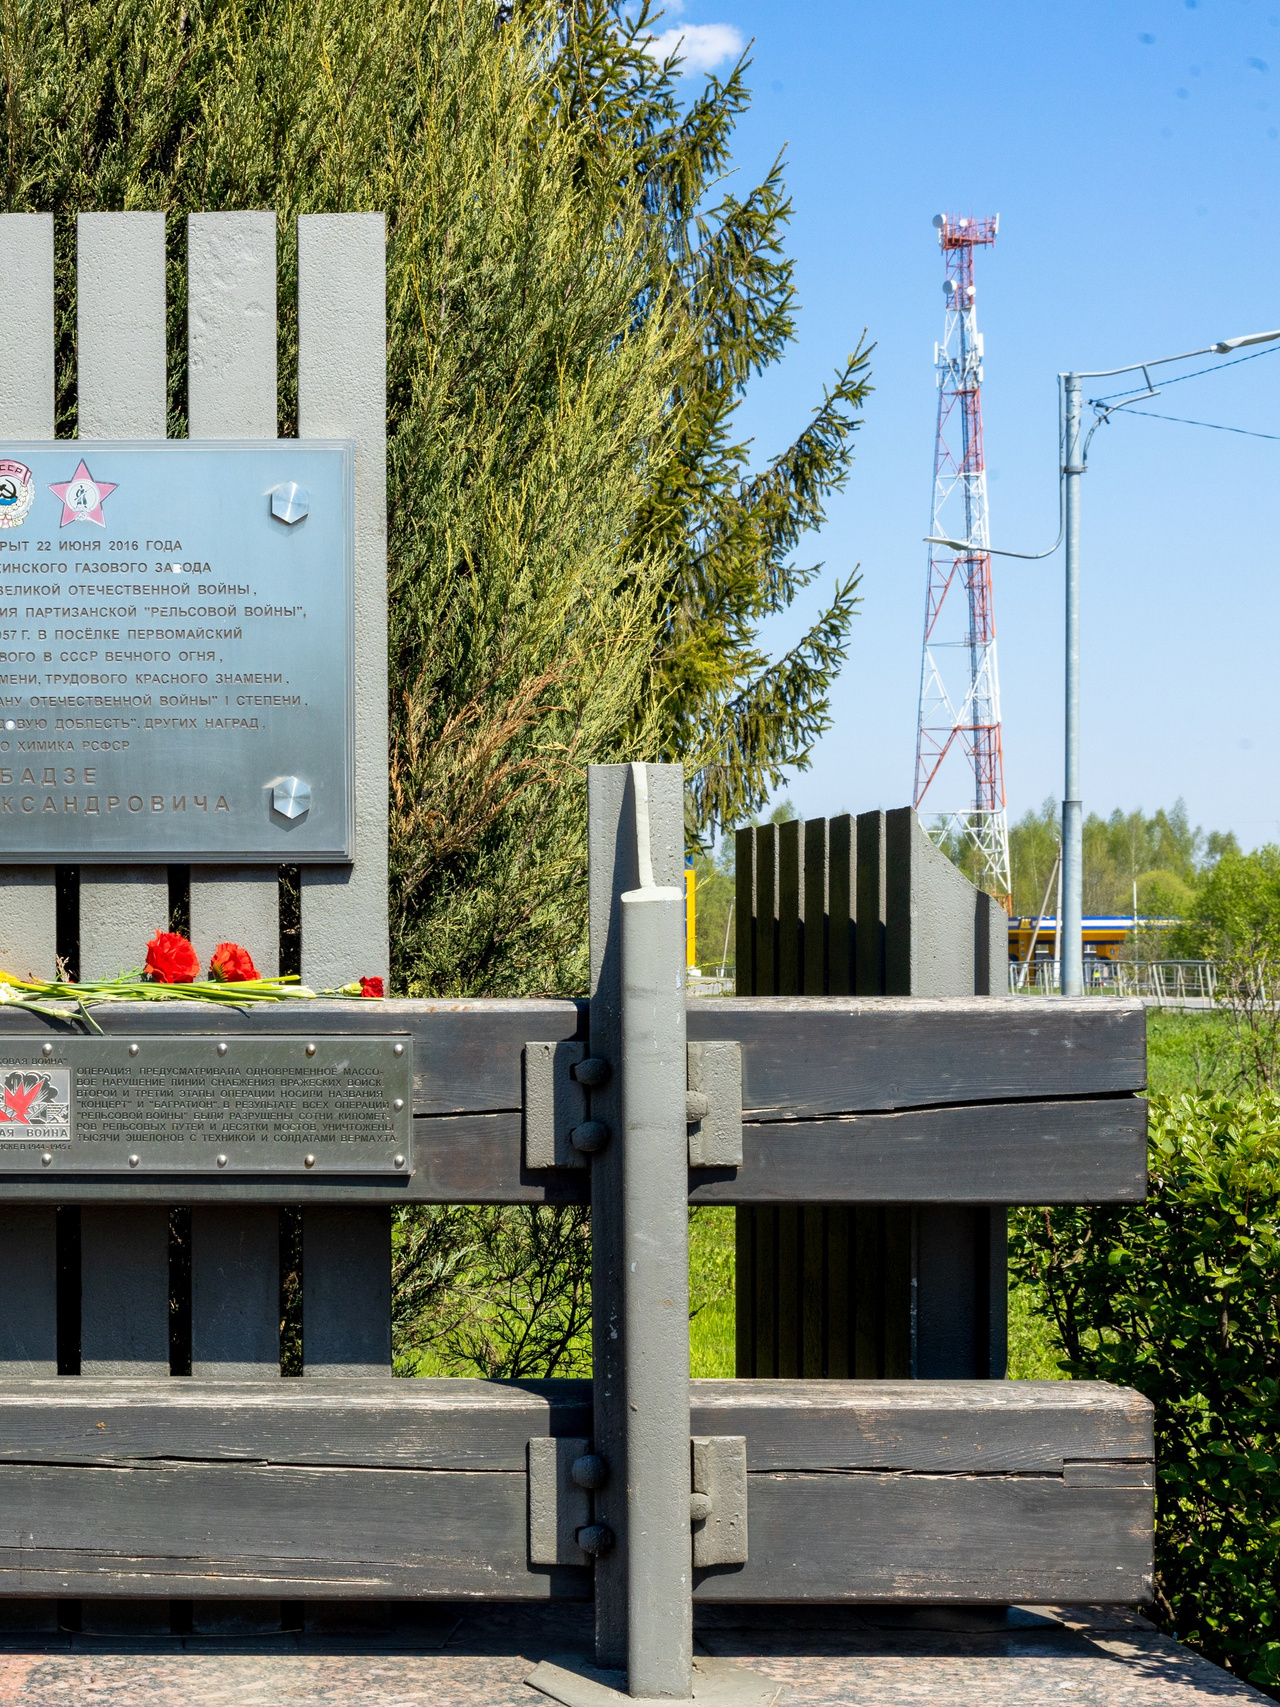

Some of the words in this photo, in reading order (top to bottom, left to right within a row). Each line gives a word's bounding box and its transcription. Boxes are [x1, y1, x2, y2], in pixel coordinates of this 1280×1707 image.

[36, 541, 51, 552] 22
[59, 541, 101, 552] ИЮНЯ
[108, 540, 139, 551] 2016
[146, 540, 183, 553] ГОДА
[75, 563, 148, 574] ГАЗОВОГО
[68, 583, 190, 596] ОТЕЧЕСТВЕННОЙ
[25, 605, 137, 618] ПАРТИЗАНСКОЙ
[144, 605, 237, 618] "РЕЛЬСОВОЙ
[38, 630, 47, 641] В
[55, 627, 120, 640] ПОСЁЛКЕ
[127, 627, 243, 640] ПЕРВОМАЙСКИЙ
[43, 652, 53, 663] В
[60, 652, 98, 663] СССР
[105, 651, 171, 662] ВЕЧНОГО
[45, 674, 128, 687] ТРУДОВОГО
[135, 674, 208, 685] КРАСНОГО
[29, 694, 152, 707] ОТЕЧЕСТВЕННОЙ
[159, 694, 218, 707] ВОЙНЫ"
[143, 718, 198, 731] ДРУГИХ
[17, 741, 75, 752] ХИМИКА
[82, 740, 130, 752] РСФСР
[76, 1067, 132, 1077] ОПЕРАЦИЯ
[139, 1067, 241, 1077] ПРЕДУСМАТРИВАЛА
[246, 1067, 338, 1077] ОДНОВРЕМЕННОЕ
[76, 1078, 97, 1087] ВОЕ
[102, 1078, 166, 1087] НАРУШЕНИЕ
[171, 1077, 206, 1087] ЛИНИЙ
[211, 1078, 275, 1087] СНАБЖЕНИЯ
[280, 1078, 342, 1087] ВРАЖЕСКИХ
[76, 1088, 117, 1098] ВТОРОЙ
[135, 1088, 174, 1098] ТРЕТИЙ
[179, 1090, 215, 1098] ЭТАПЫ
[220, 1090, 275, 1099] ОПЕРАЦИИ
[280, 1090, 323, 1098] НОСИЛИ
[328, 1090, 383, 1098] НАЗВАНИЯ
[235, 1101, 297, 1109] РЕЗУЛЬТАТЕ
[302, 1101, 329, 1109] ВСЕХ
[334, 1099, 390, 1111] ОПЕРАЦИЙ
[193, 1112, 224, 1120] БЫЛИ
[229, 1112, 293, 1120] РАЗРУШЕНЫ
[298, 1112, 333, 1120] СОТНИ
[26, 1127, 68, 1138] ВОЙНА
[76, 1123, 97, 1131] РОВ
[102, 1123, 166, 1131] РЕЛЬСОВЫХ
[172, 1122, 204, 1132] ПУТЕЙ
[222, 1123, 268, 1133] ДЕСЯТКИ
[322, 1123, 394, 1132] УНИЧТОЖЕНЫ
[78, 1134, 120, 1142] ТЫСЯЧИ
[125, 1134, 184, 1142] ЭШЕЛОНОВ
[202, 1133, 256, 1143] ТЕХНИКОЙ
[273, 1134, 336, 1144] СОЛДАТАМИ
